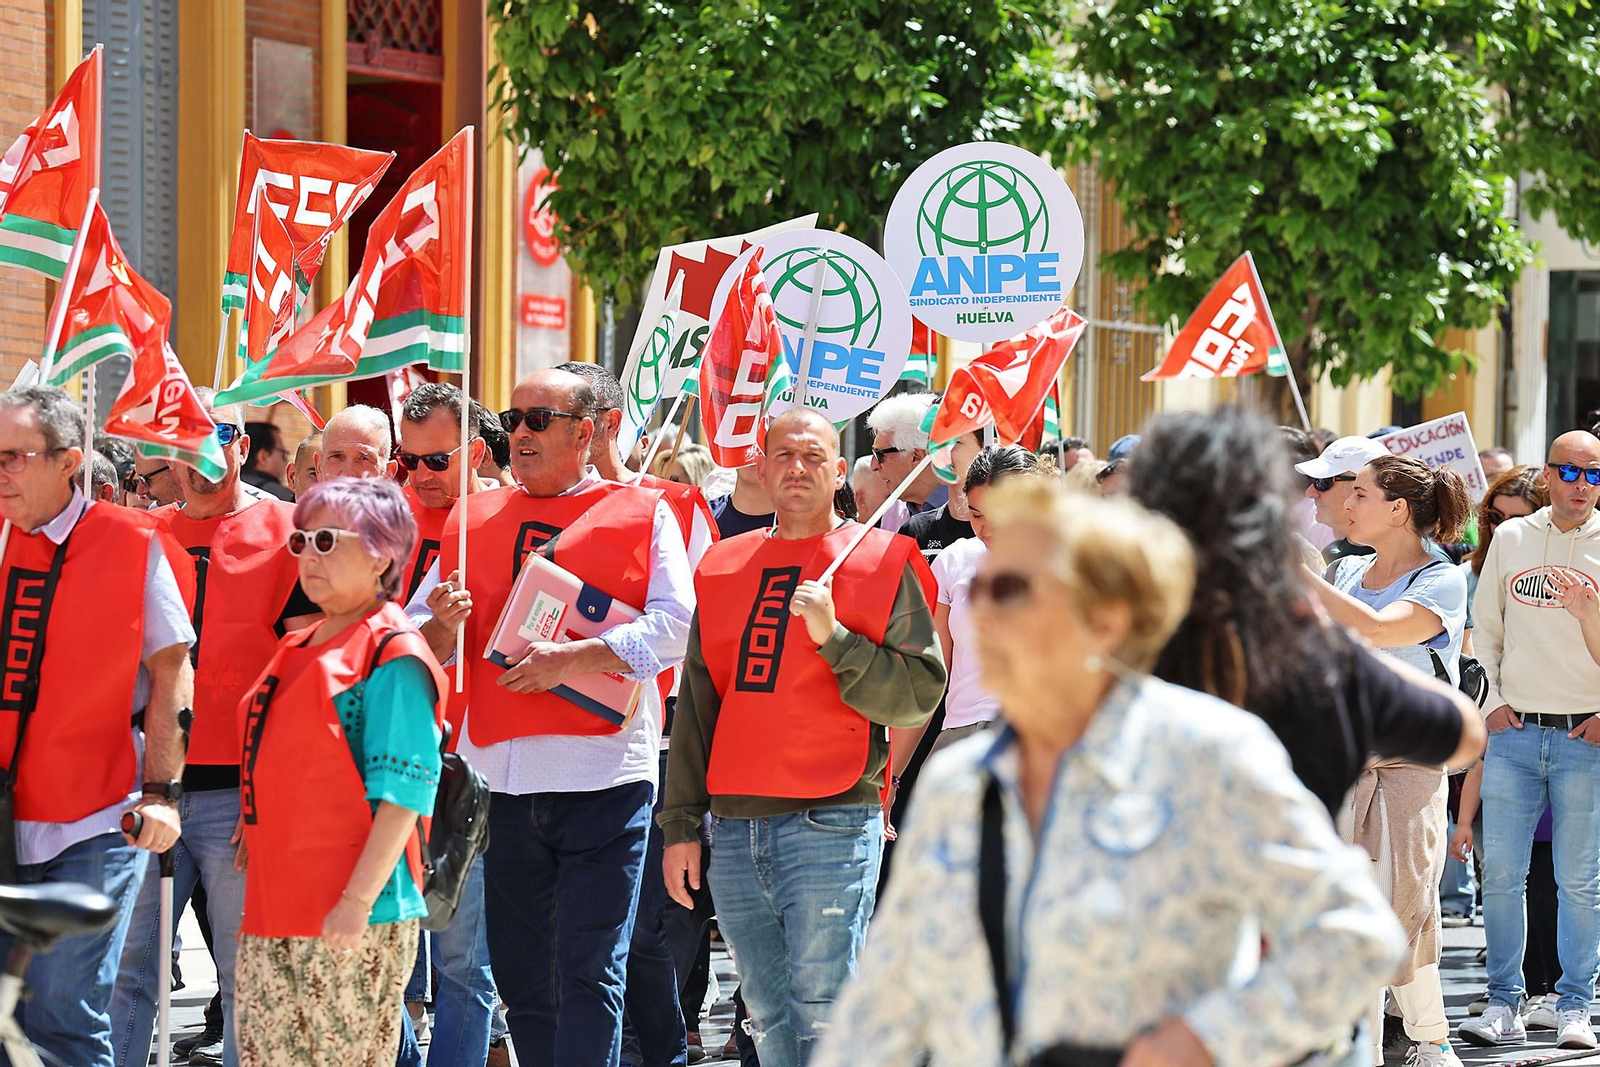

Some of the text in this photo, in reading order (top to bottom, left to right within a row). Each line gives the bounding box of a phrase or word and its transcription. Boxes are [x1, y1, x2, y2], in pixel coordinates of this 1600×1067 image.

[909, 253, 1061, 296] ANPE
[909, 293, 1062, 307] SINDICATO INDEPENDIENTE
[956, 311, 1014, 324] HUELVA
[782, 334, 885, 390] NPE
[1419, 447, 1465, 468] ENDE
[542, 615, 554, 637] CCOO
[743, 573, 791, 684] CCOO
